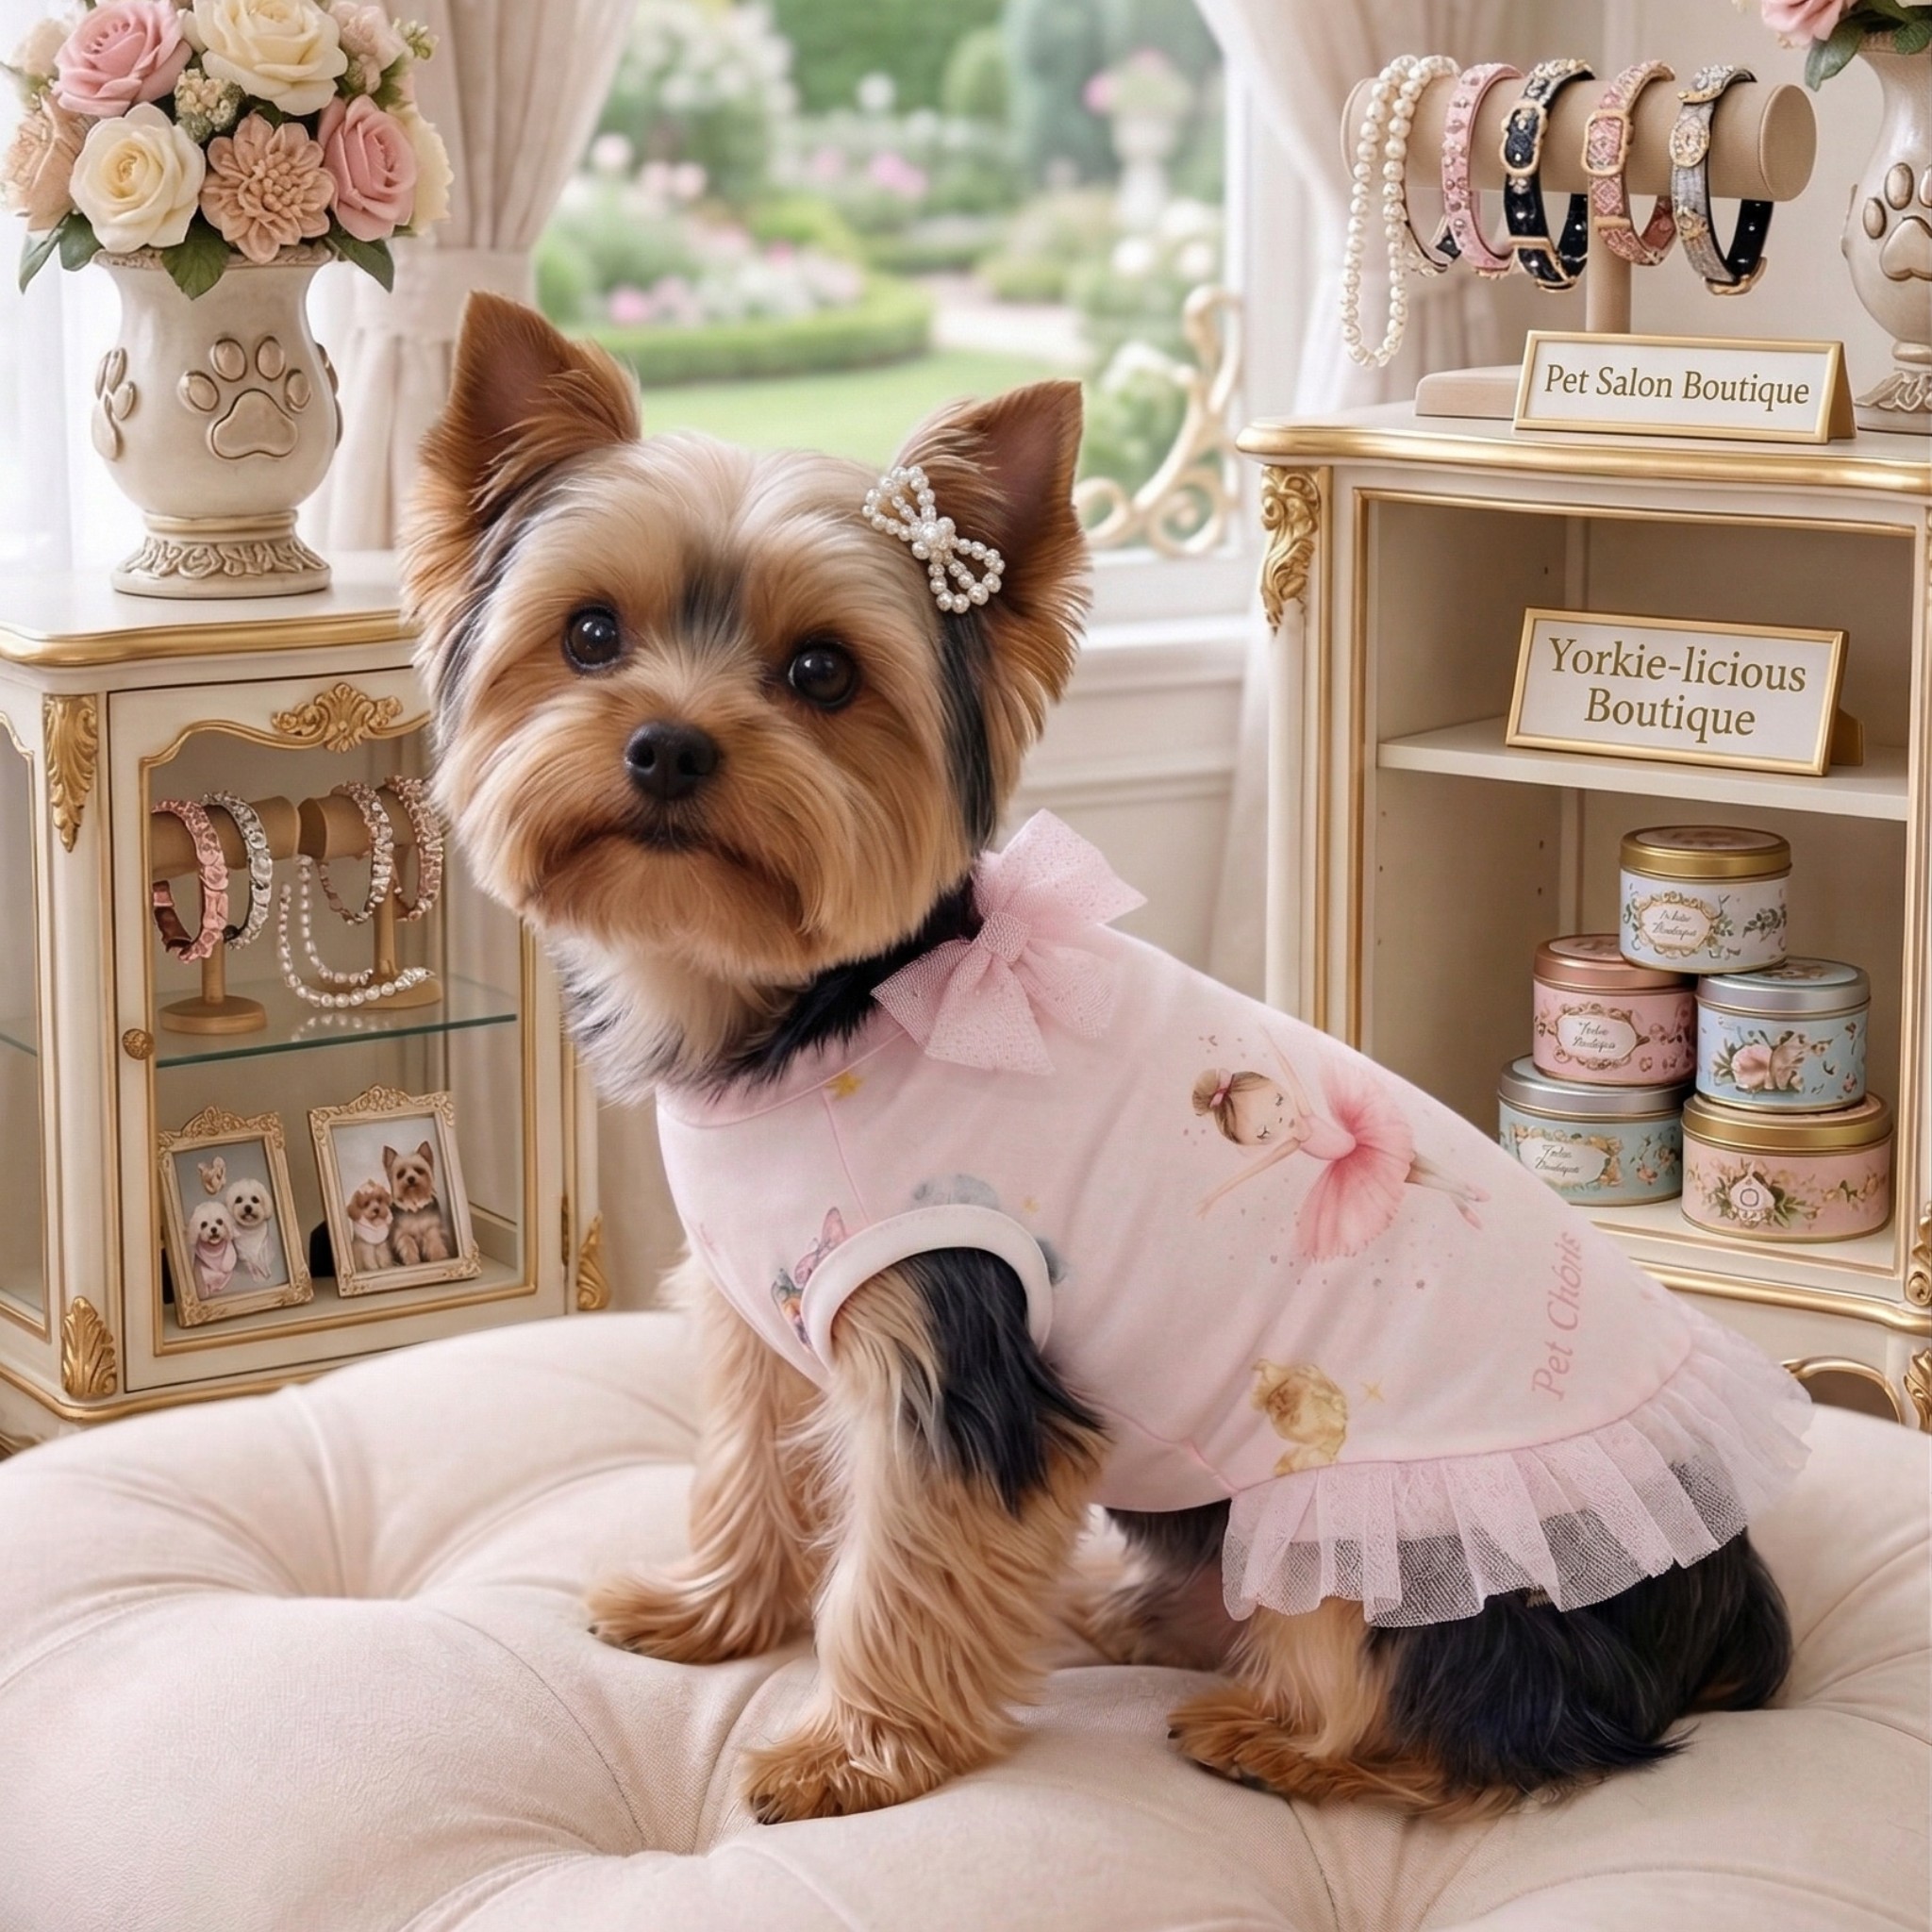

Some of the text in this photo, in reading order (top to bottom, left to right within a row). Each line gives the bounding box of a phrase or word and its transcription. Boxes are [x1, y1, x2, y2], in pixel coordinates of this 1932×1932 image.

[1544, 364, 1809, 411] Pet Salon Boutique
[1548, 637, 1807, 691] Yorkie-licious
[1584, 687, 1756, 743] Boutique
[1531, 1340, 1574, 1402] Pet
